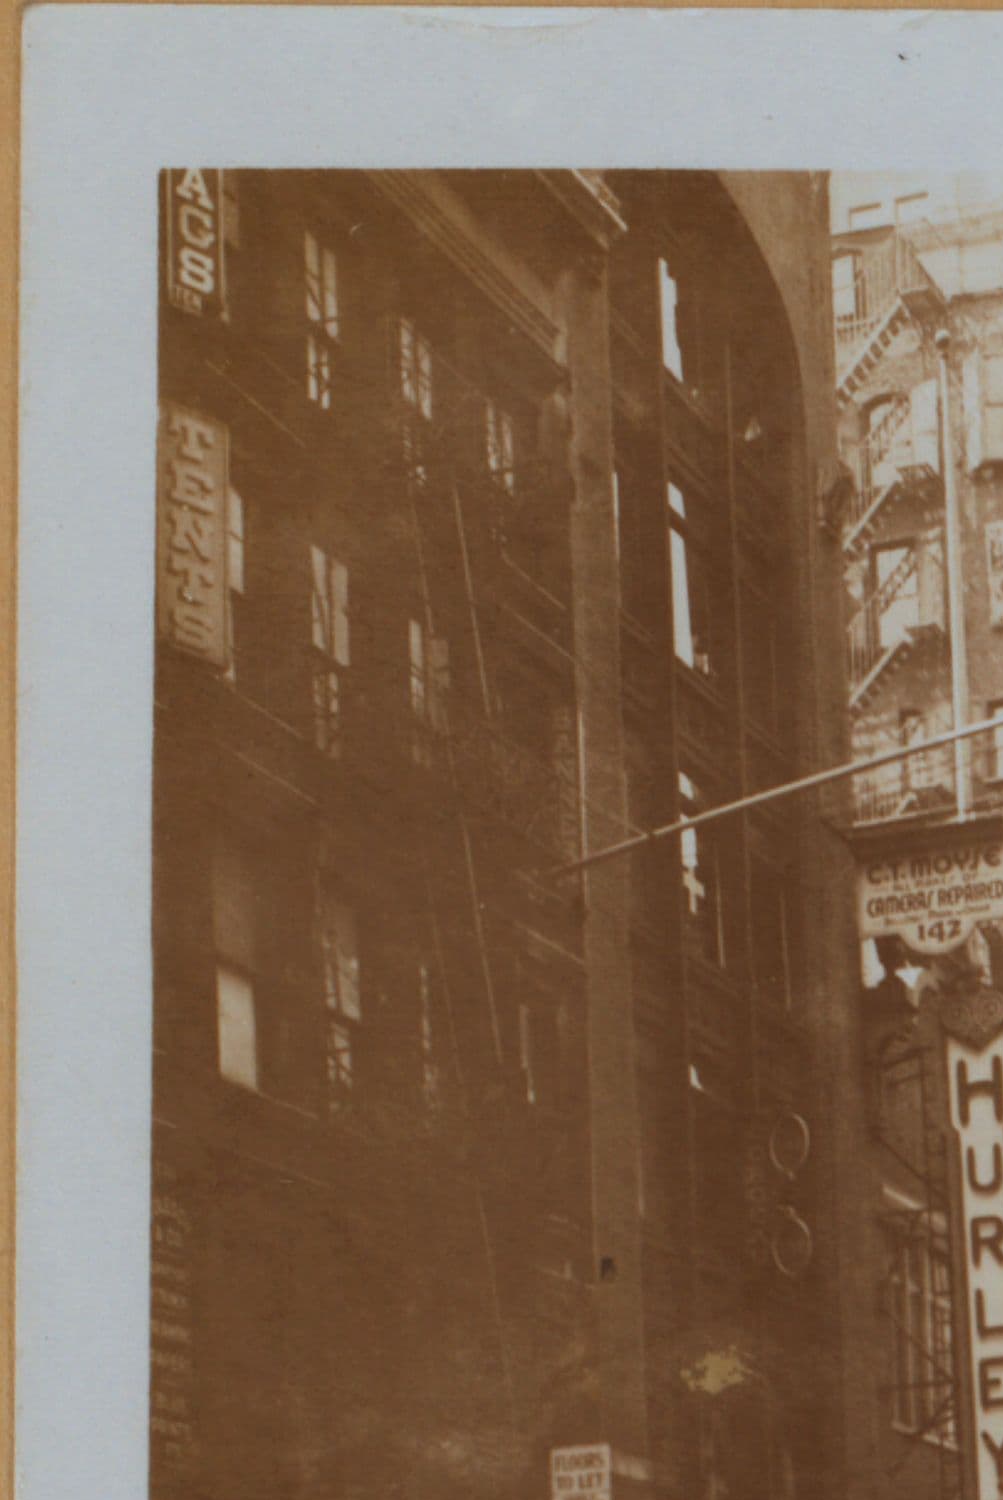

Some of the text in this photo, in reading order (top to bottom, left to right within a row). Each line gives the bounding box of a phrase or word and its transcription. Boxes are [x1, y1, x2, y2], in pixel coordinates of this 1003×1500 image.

[866, 889, 934, 918] CAMERAS
[917, 919, 961, 942] 142
[556, 1471, 603, 1491] TO LET
